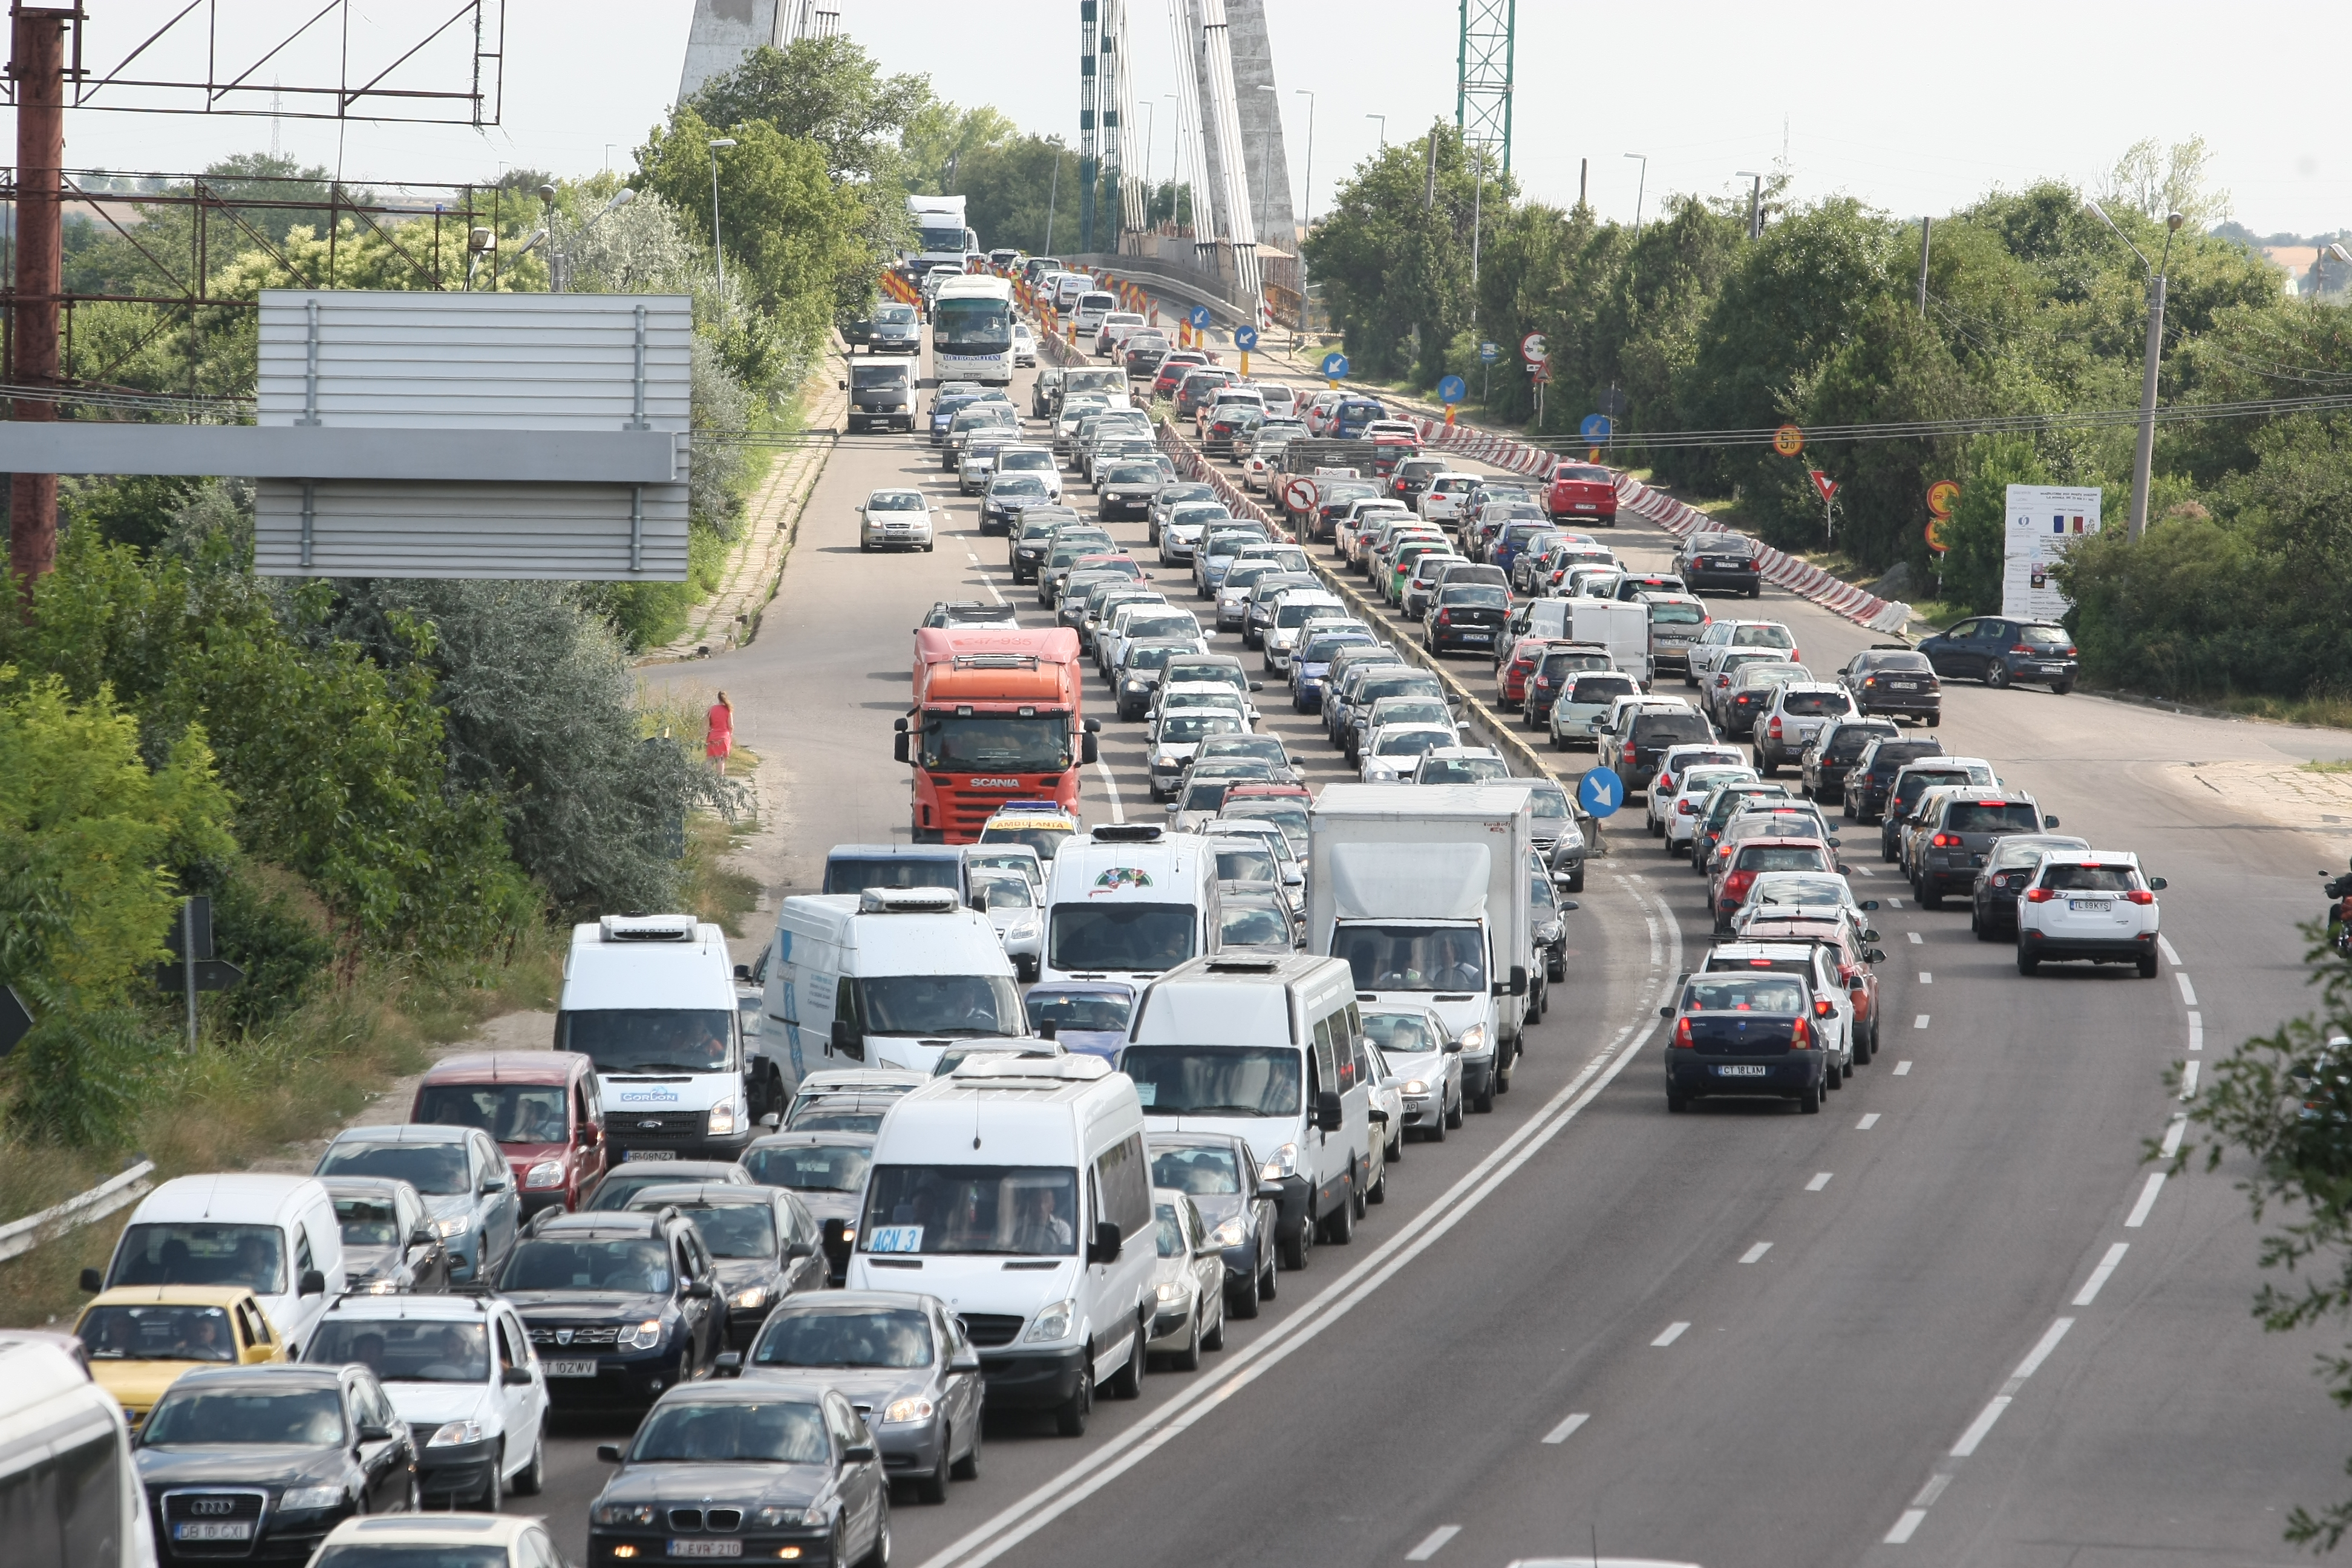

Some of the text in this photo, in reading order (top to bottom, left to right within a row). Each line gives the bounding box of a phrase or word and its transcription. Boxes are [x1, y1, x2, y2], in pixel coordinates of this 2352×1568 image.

[970, 778, 1020, 788] SCANIA
[872, 1229, 916, 1252] ACN 3
[181, 1526, 198, 1538] DB
